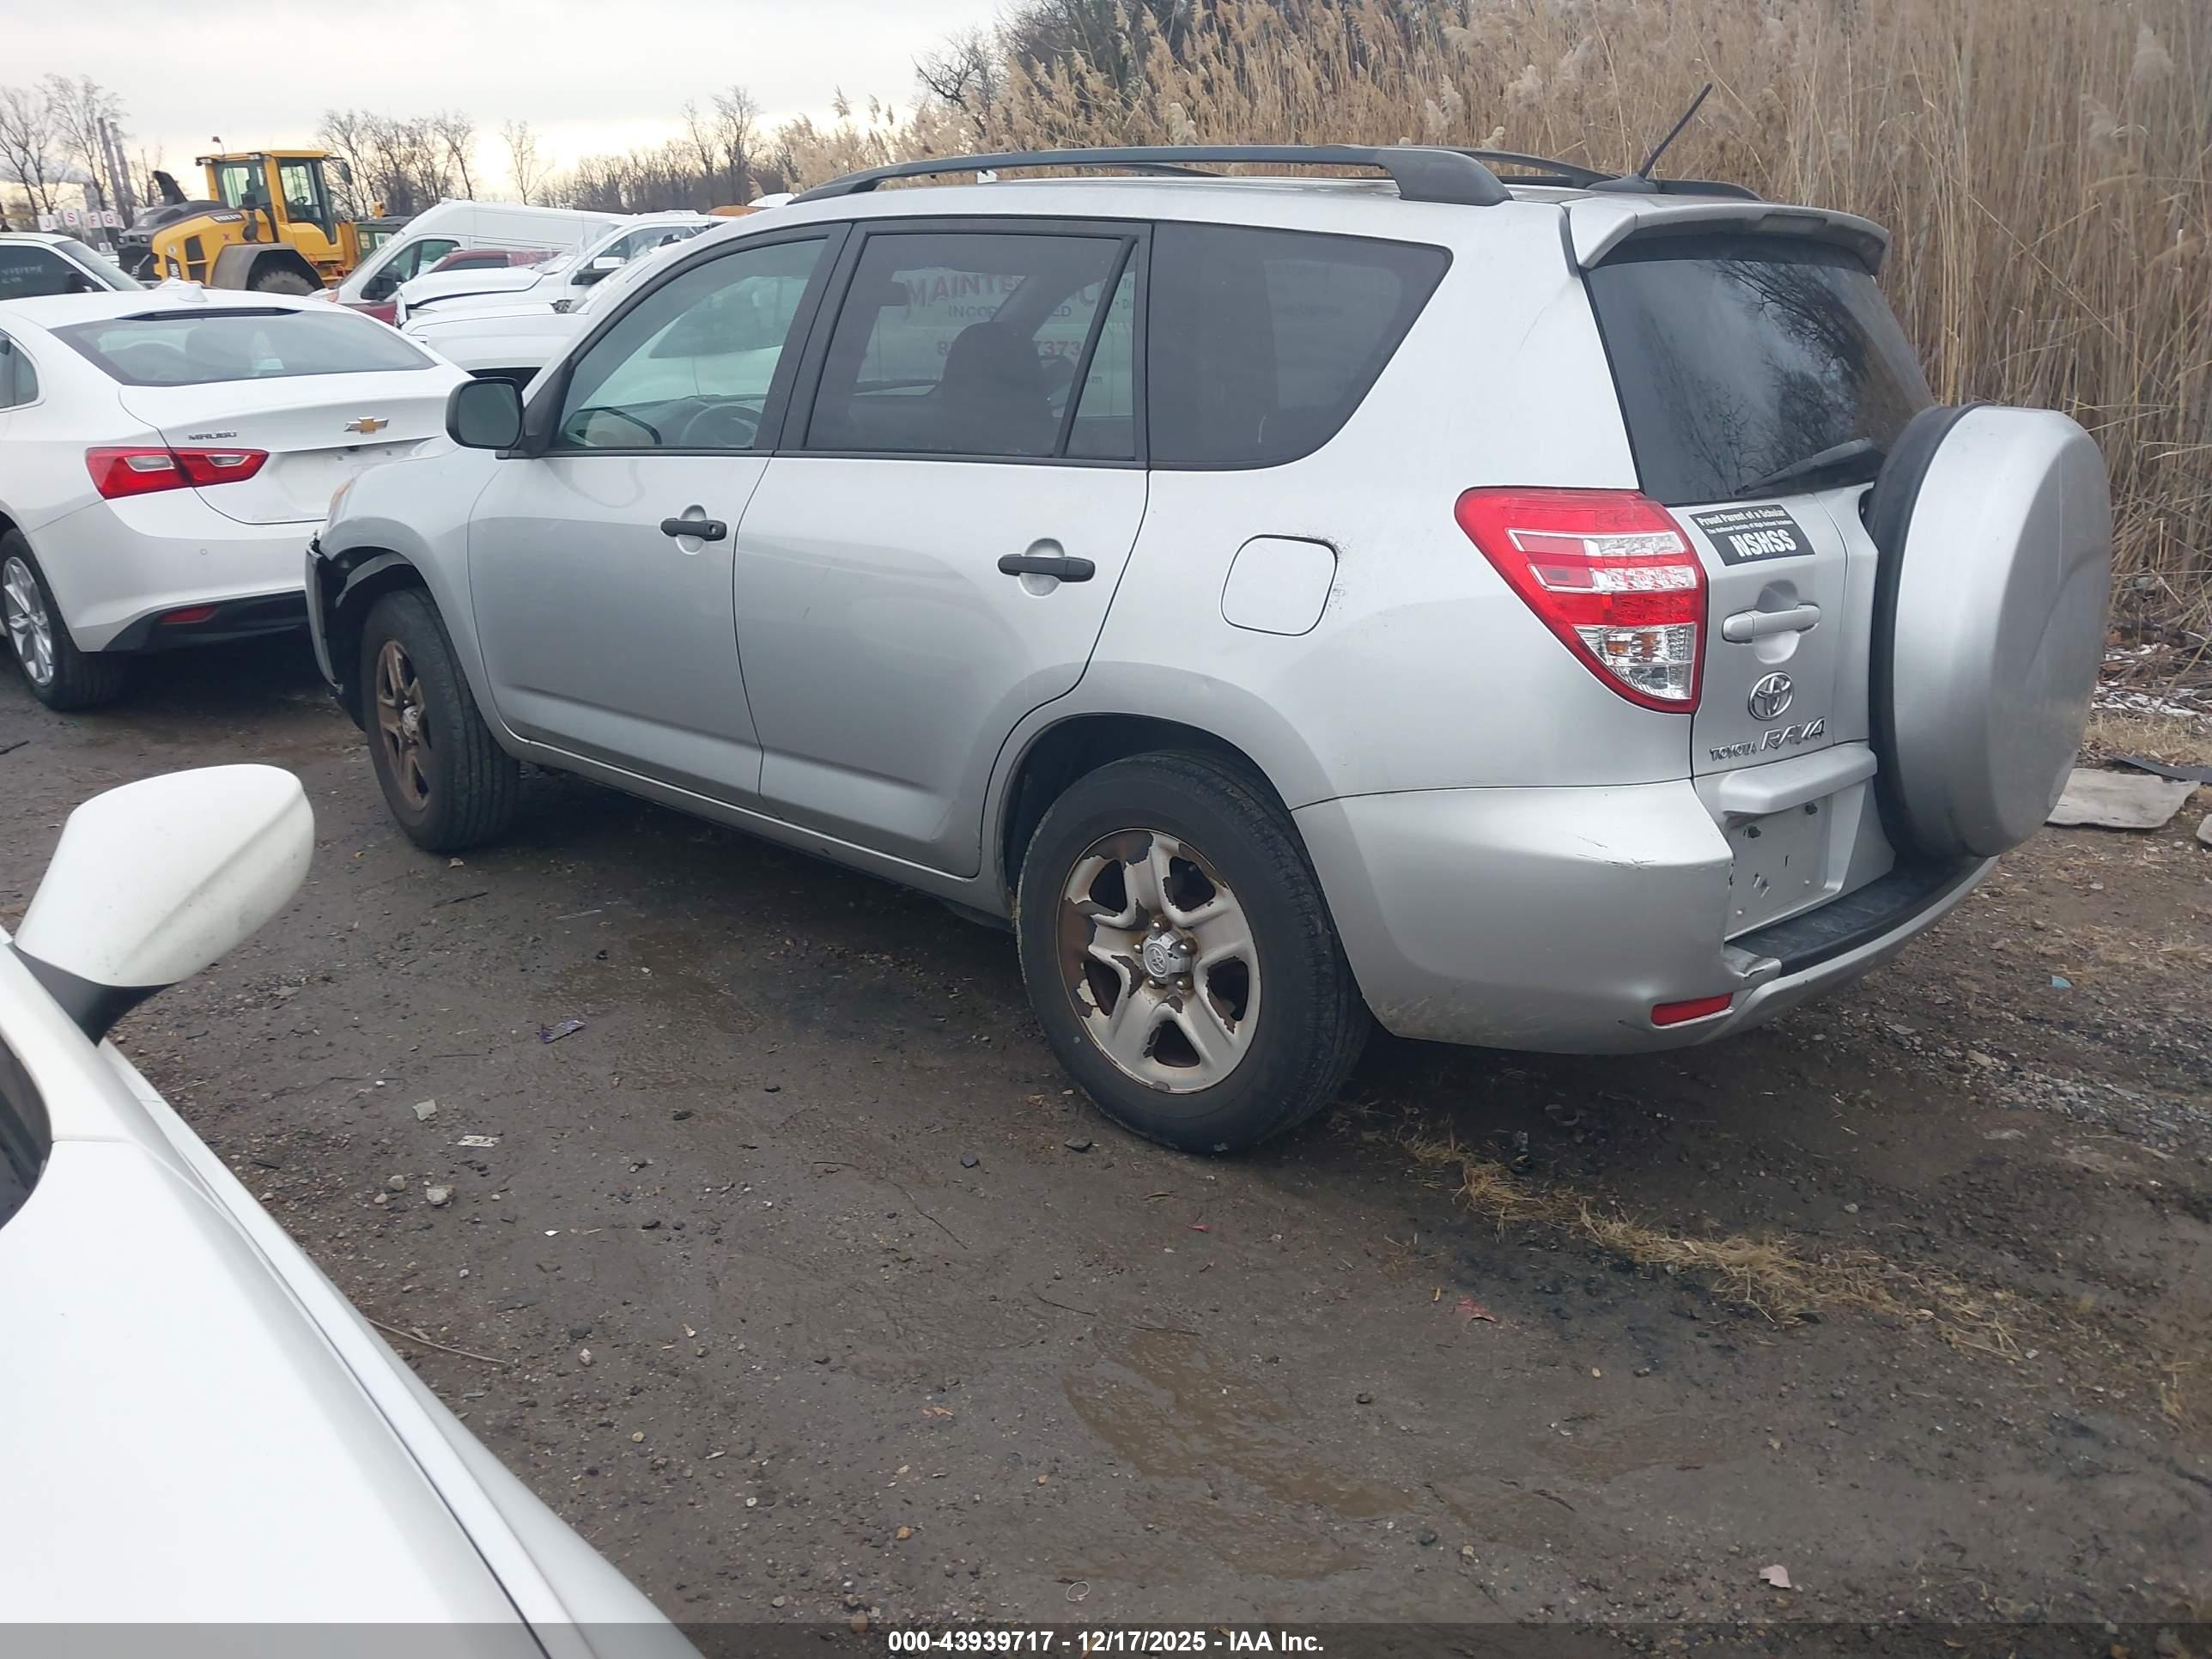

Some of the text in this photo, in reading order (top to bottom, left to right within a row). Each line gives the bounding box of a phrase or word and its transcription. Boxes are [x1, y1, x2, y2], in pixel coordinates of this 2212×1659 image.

[68, 213, 76, 222] S
[89, 215, 96, 225] F
[105, 214, 113, 223] G
[1697, 514, 1724, 526] Proud
[1719, 512, 1747, 523] Parent
[1745, 511, 1756, 520] of
[1758, 508, 1787, 518] Scholar
[1728, 529, 1797, 557] NSHSS
[1710, 716, 1826, 762] TOYOTA RAV4
